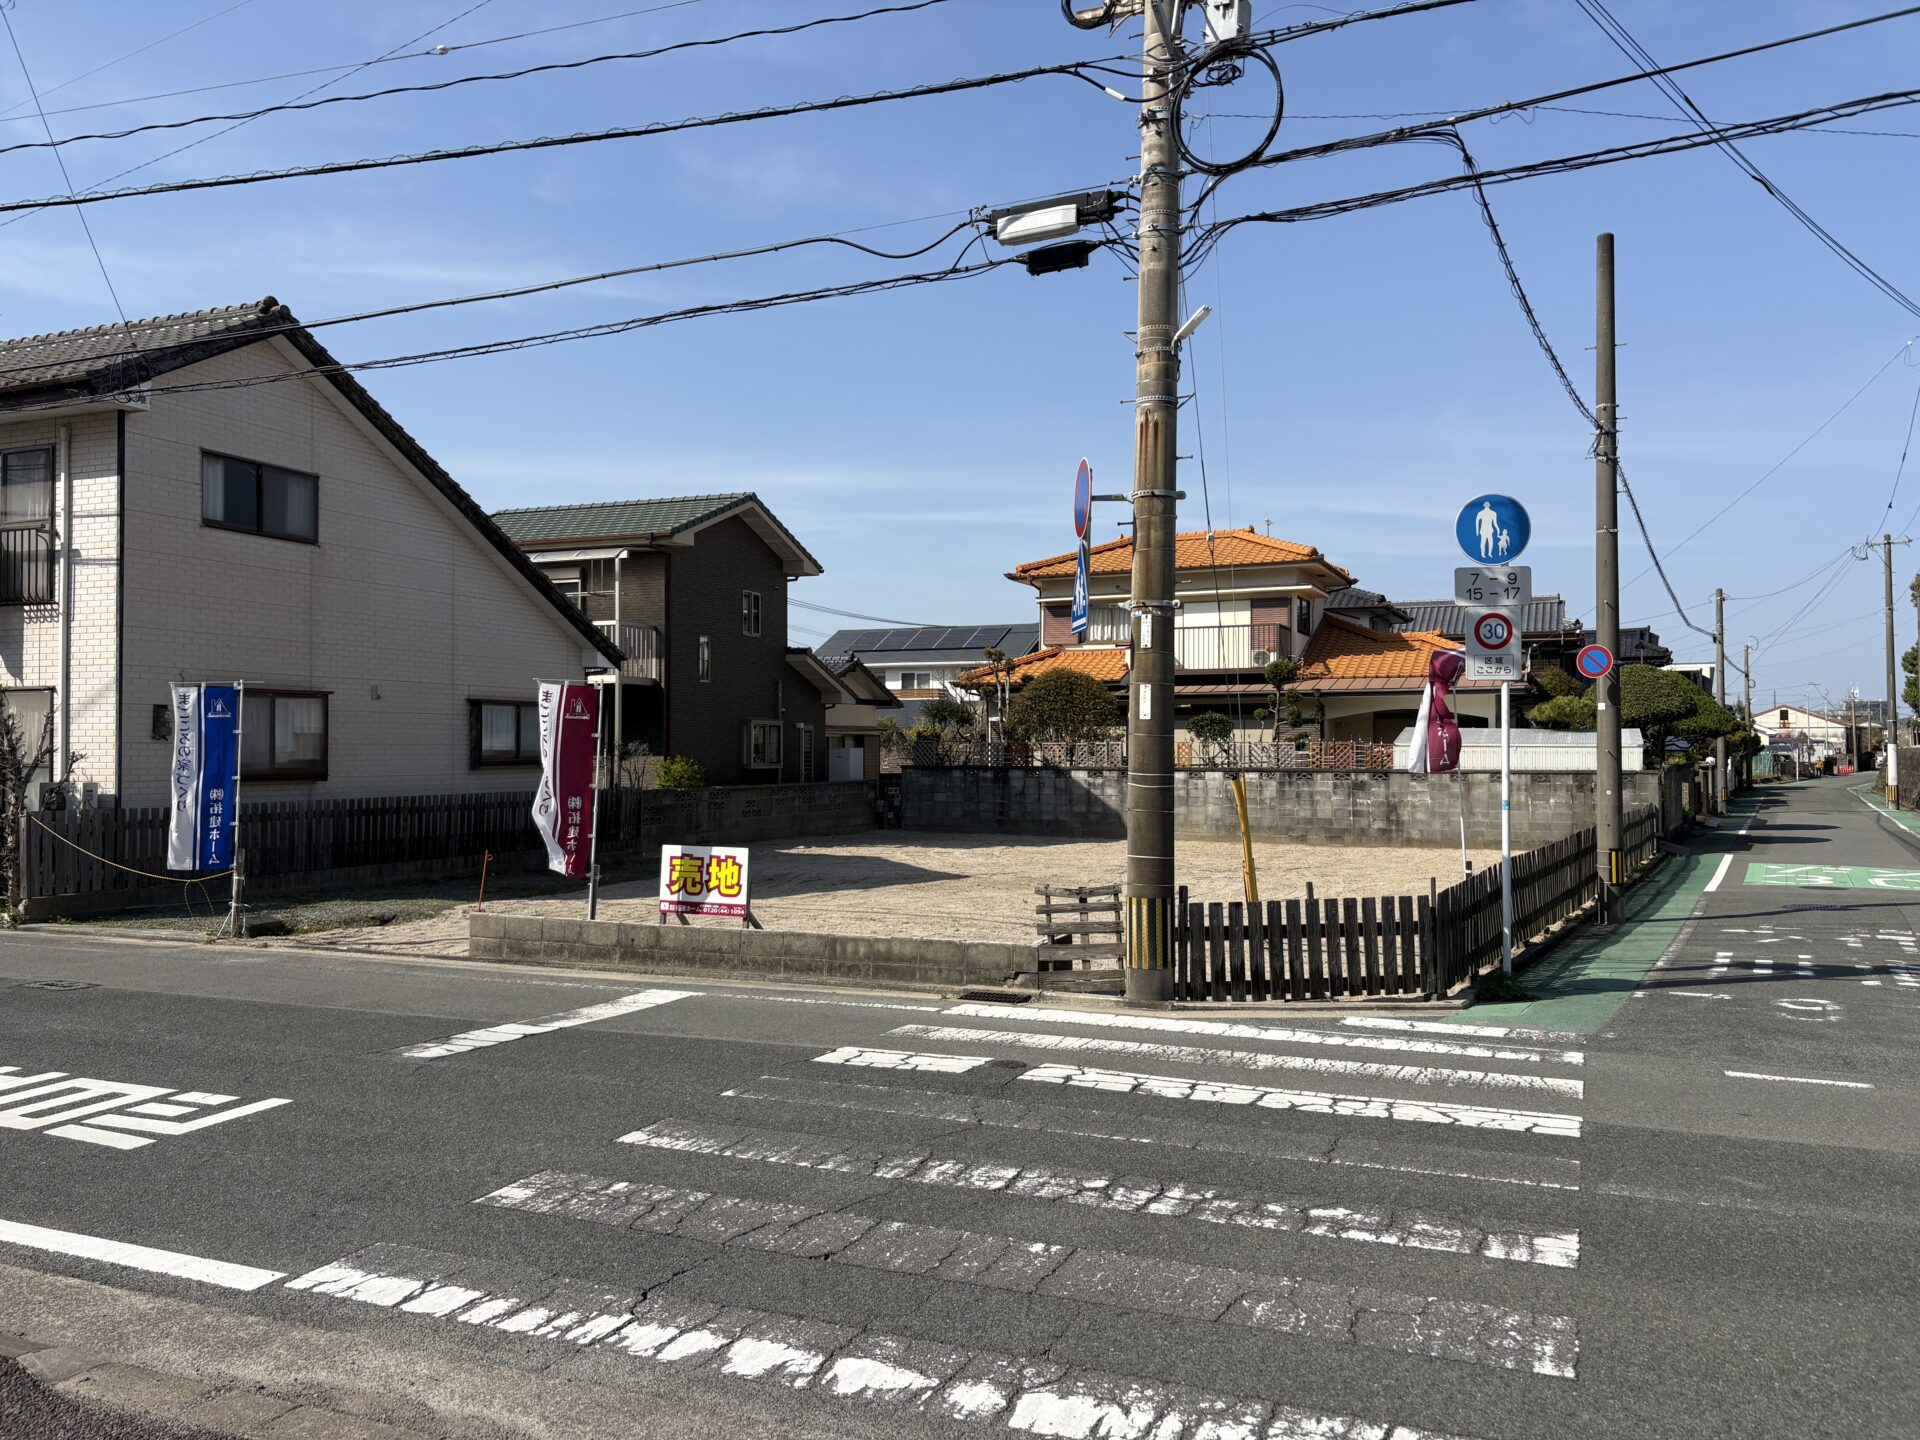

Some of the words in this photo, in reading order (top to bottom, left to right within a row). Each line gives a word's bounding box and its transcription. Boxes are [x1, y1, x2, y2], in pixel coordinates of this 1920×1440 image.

[1466, 587, 1483, 601] 15
[1503, 587, 1520, 600] 17
[1483, 623, 1505, 640] 30
[1476, 666, 1512, 674] ここから
[666, 853, 743, 898] 売地
